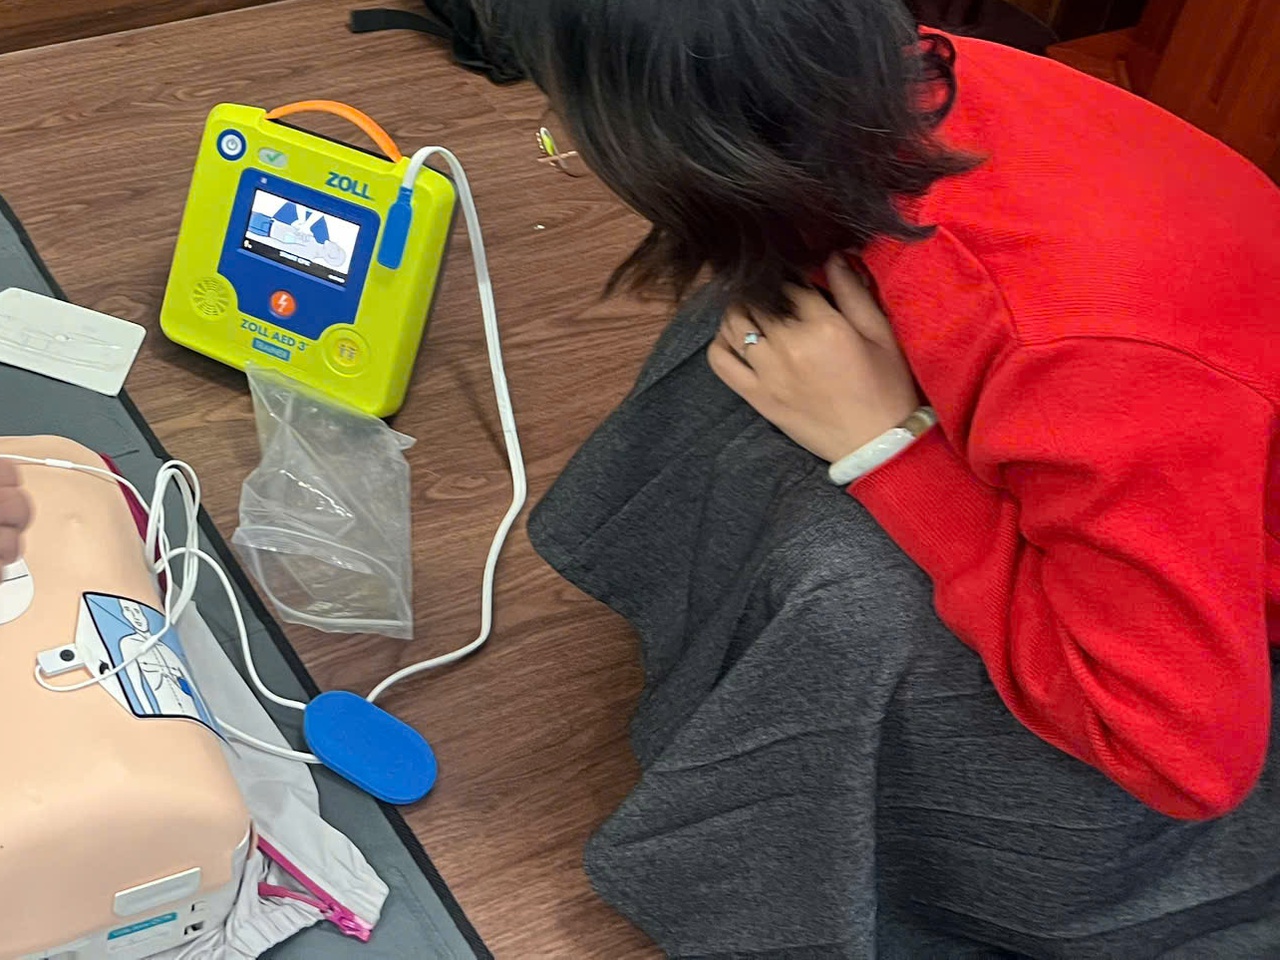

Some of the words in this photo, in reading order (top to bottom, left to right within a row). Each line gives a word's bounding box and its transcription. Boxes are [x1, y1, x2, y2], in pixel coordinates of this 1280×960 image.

[325, 171, 375, 200] ZOLL
[241, 319, 269, 338] ZOLL
[272, 332, 296, 347] AED
